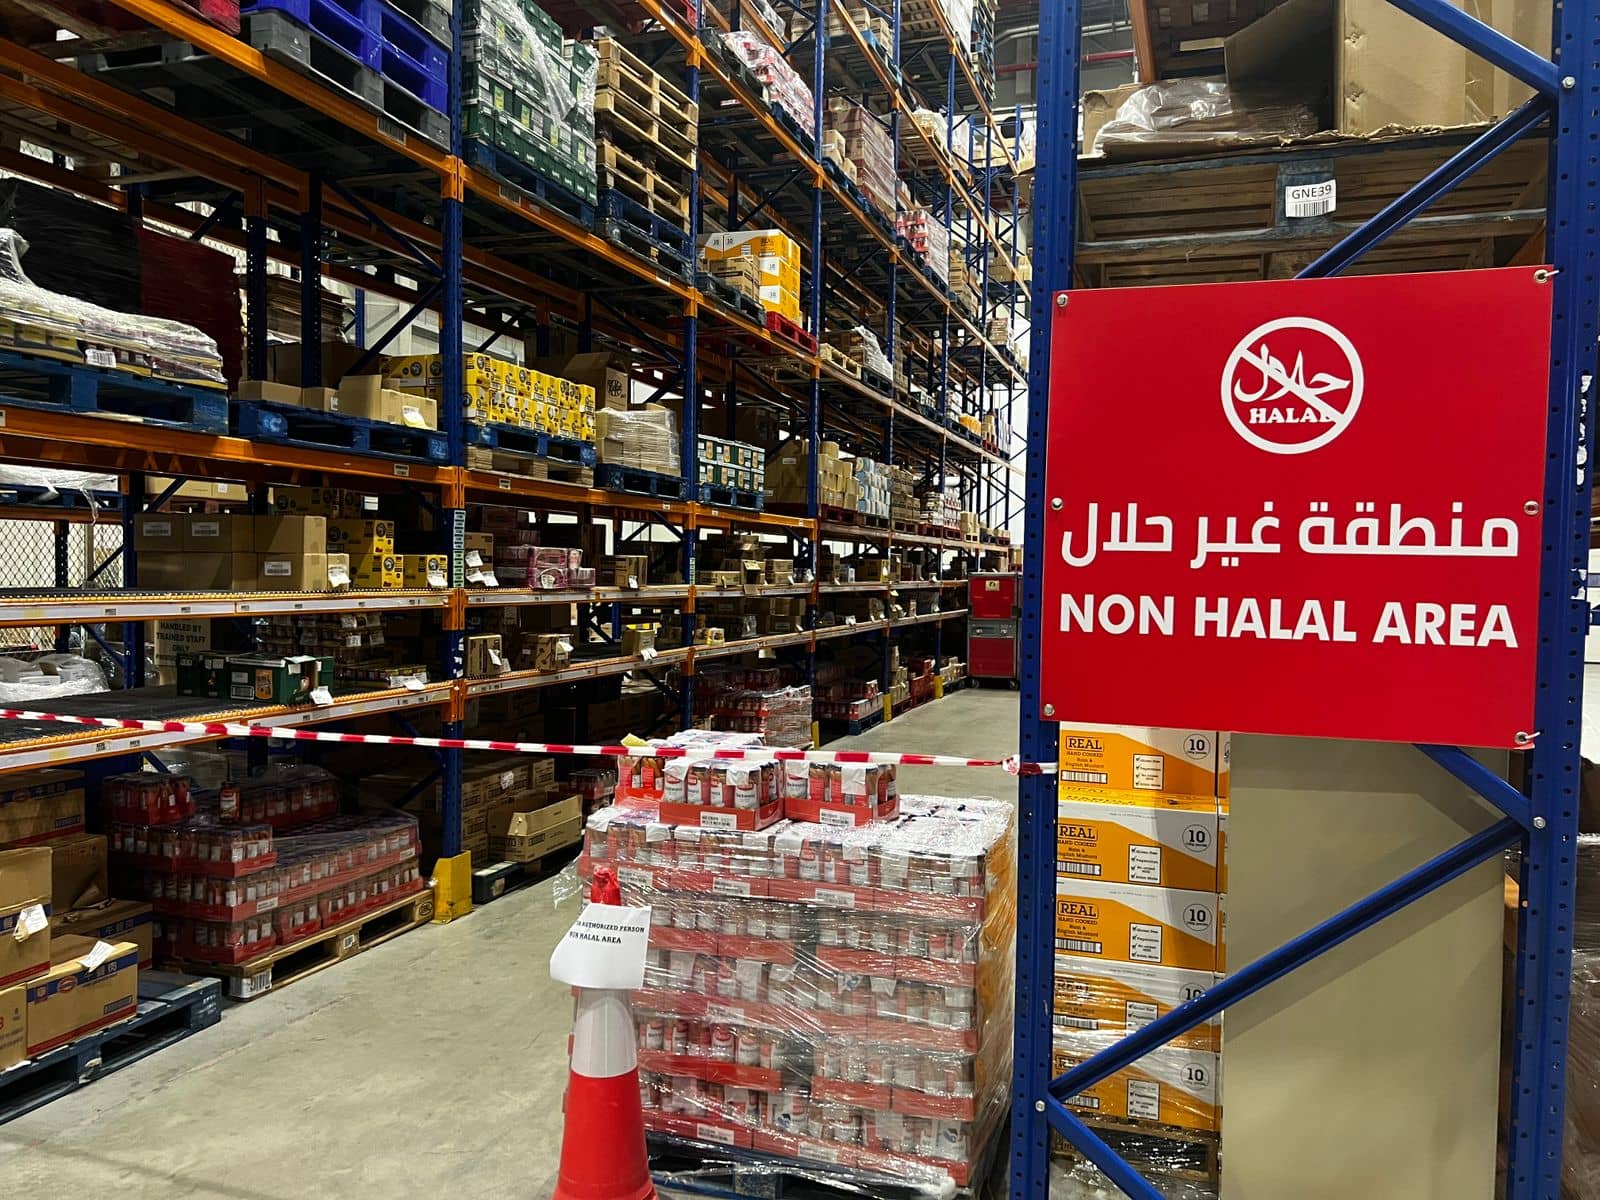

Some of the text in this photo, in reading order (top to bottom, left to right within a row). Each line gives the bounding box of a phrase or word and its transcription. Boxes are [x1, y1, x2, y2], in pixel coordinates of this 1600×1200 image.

[1292, 184, 1332, 200] GNE39
[1062, 501, 1518, 569] منطقة غير حلال
[1060, 593, 1519, 649] NON HALAL AREA
[1068, 738, 1103, 750] REAL
[1189, 738, 1205, 751] 10
[1059, 825, 1096, 839] REAL
[1188, 829, 1206, 843] 10
[1060, 902, 1097, 917] REAL
[1189, 908, 1207, 922] 10
[581, 921, 619, 931] AUTHORIZED
[619, 925, 645, 933] PERSON
[579, 932, 601, 942] HALAL
[601, 935, 622, 944] AREA
[1186, 1067, 1204, 1082] 10
